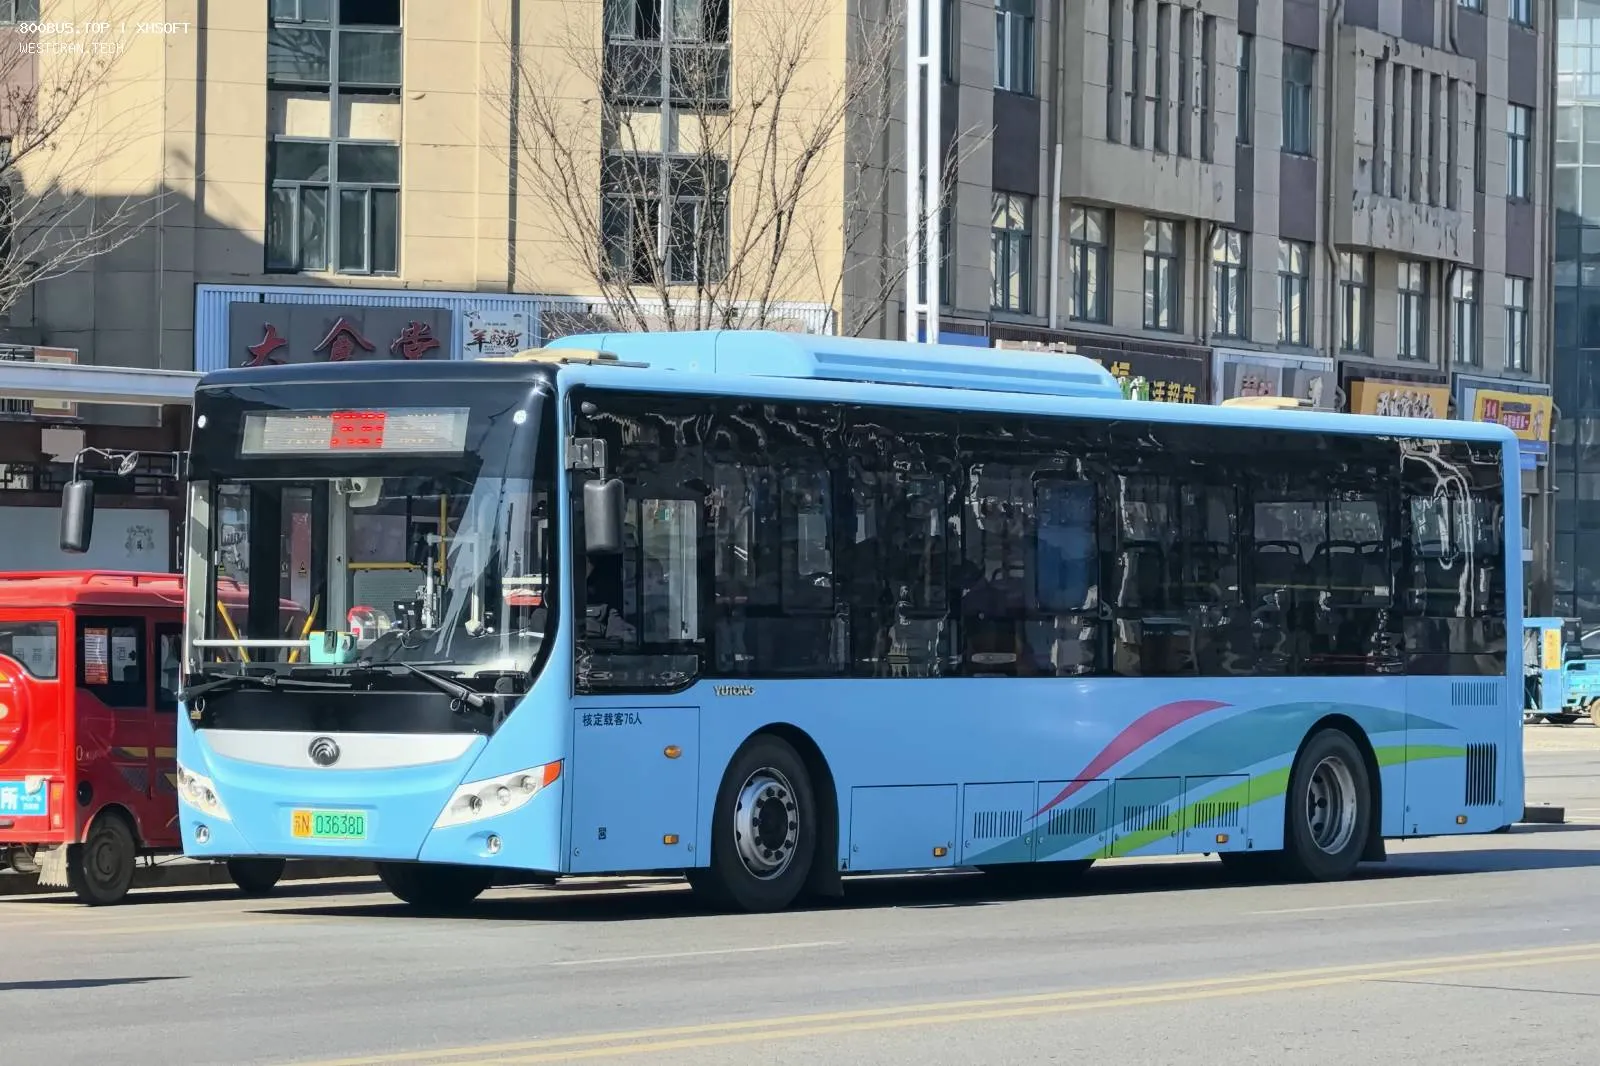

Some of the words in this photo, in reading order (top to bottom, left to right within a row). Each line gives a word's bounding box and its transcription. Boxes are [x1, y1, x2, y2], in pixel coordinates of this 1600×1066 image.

[582, 712, 642, 727] 核定载客76人
